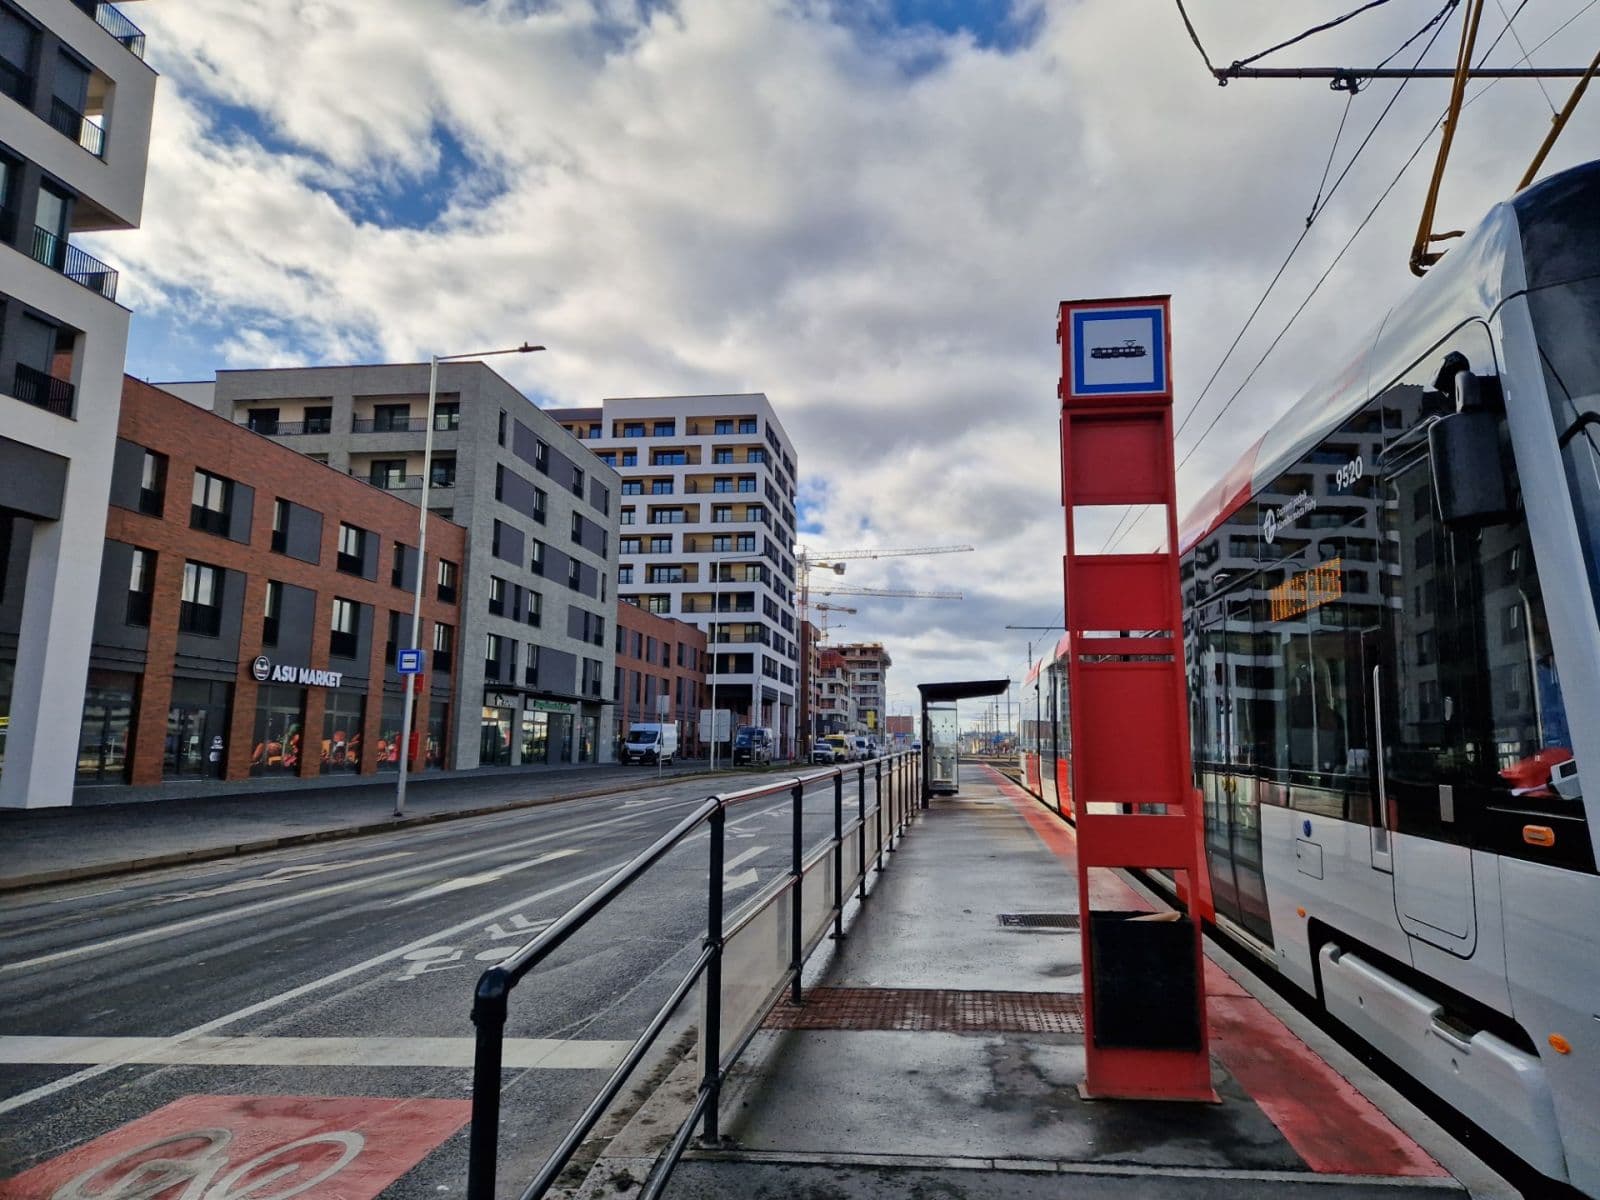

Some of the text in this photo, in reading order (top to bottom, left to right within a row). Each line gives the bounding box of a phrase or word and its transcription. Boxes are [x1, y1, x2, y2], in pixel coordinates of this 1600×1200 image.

[1336, 456, 1362, 491] 9520
[272, 665, 342, 688] ASU MARKET
